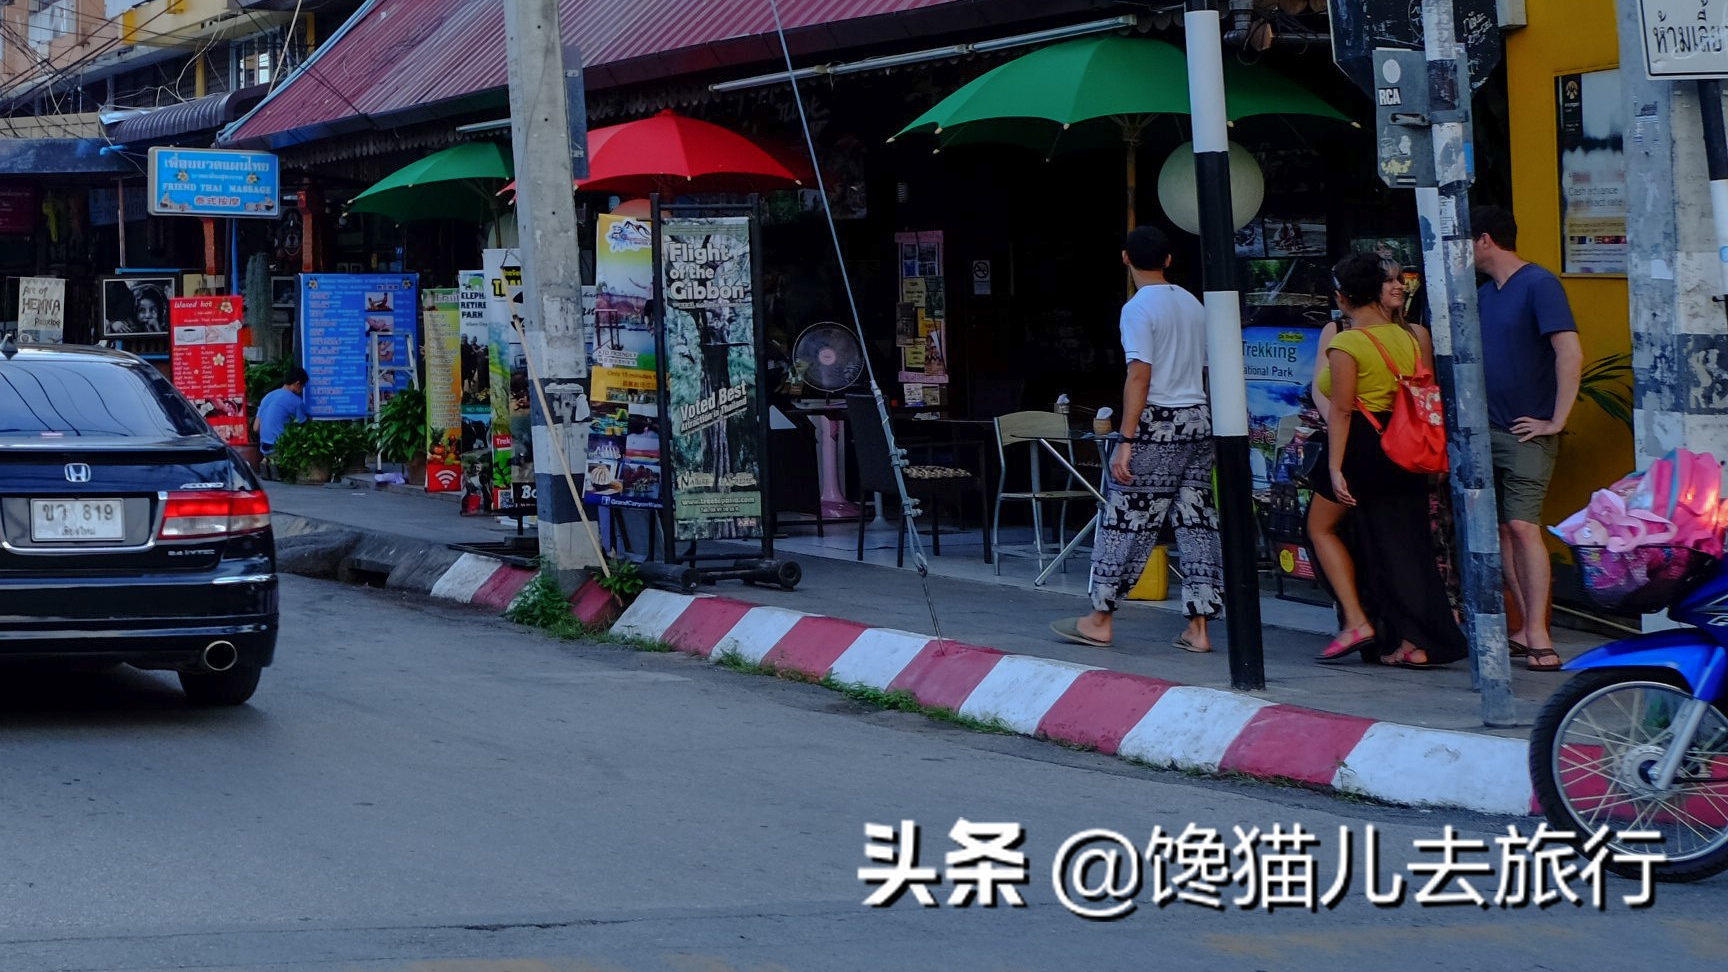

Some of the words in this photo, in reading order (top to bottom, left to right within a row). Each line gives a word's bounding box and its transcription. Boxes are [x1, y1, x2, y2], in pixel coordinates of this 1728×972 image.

[1378, 88, 1401, 105] RCA
[162, 182, 197, 191] FRIEND
[200, 184, 222, 192] THAI
[229, 185, 272, 194] MASSAGE
[1568, 187, 1586, 196] Cash
[194, 196, 240, 206] 泰式按摩
[669, 242, 730, 265] Flight
[669, 265, 686, 280] of
[688, 264, 715, 280] the
[38, 287, 48, 297] of
[670, 280, 745, 300] Gibbon
[22, 298, 61, 315] HENNA
[461, 311, 483, 319] PARK
[1242, 340, 1297, 362] Trekking
[607, 370, 621, 378] Only
[1243, 367, 1269, 375] ational
[1271, 366, 1293, 377] Park
[680, 392, 716, 422] Voted
[718, 380, 747, 406] Best
[680, 410, 712, 433] Attraction
[721, 395, 747, 414] Thailand
[82, 504, 113, 521] 819
